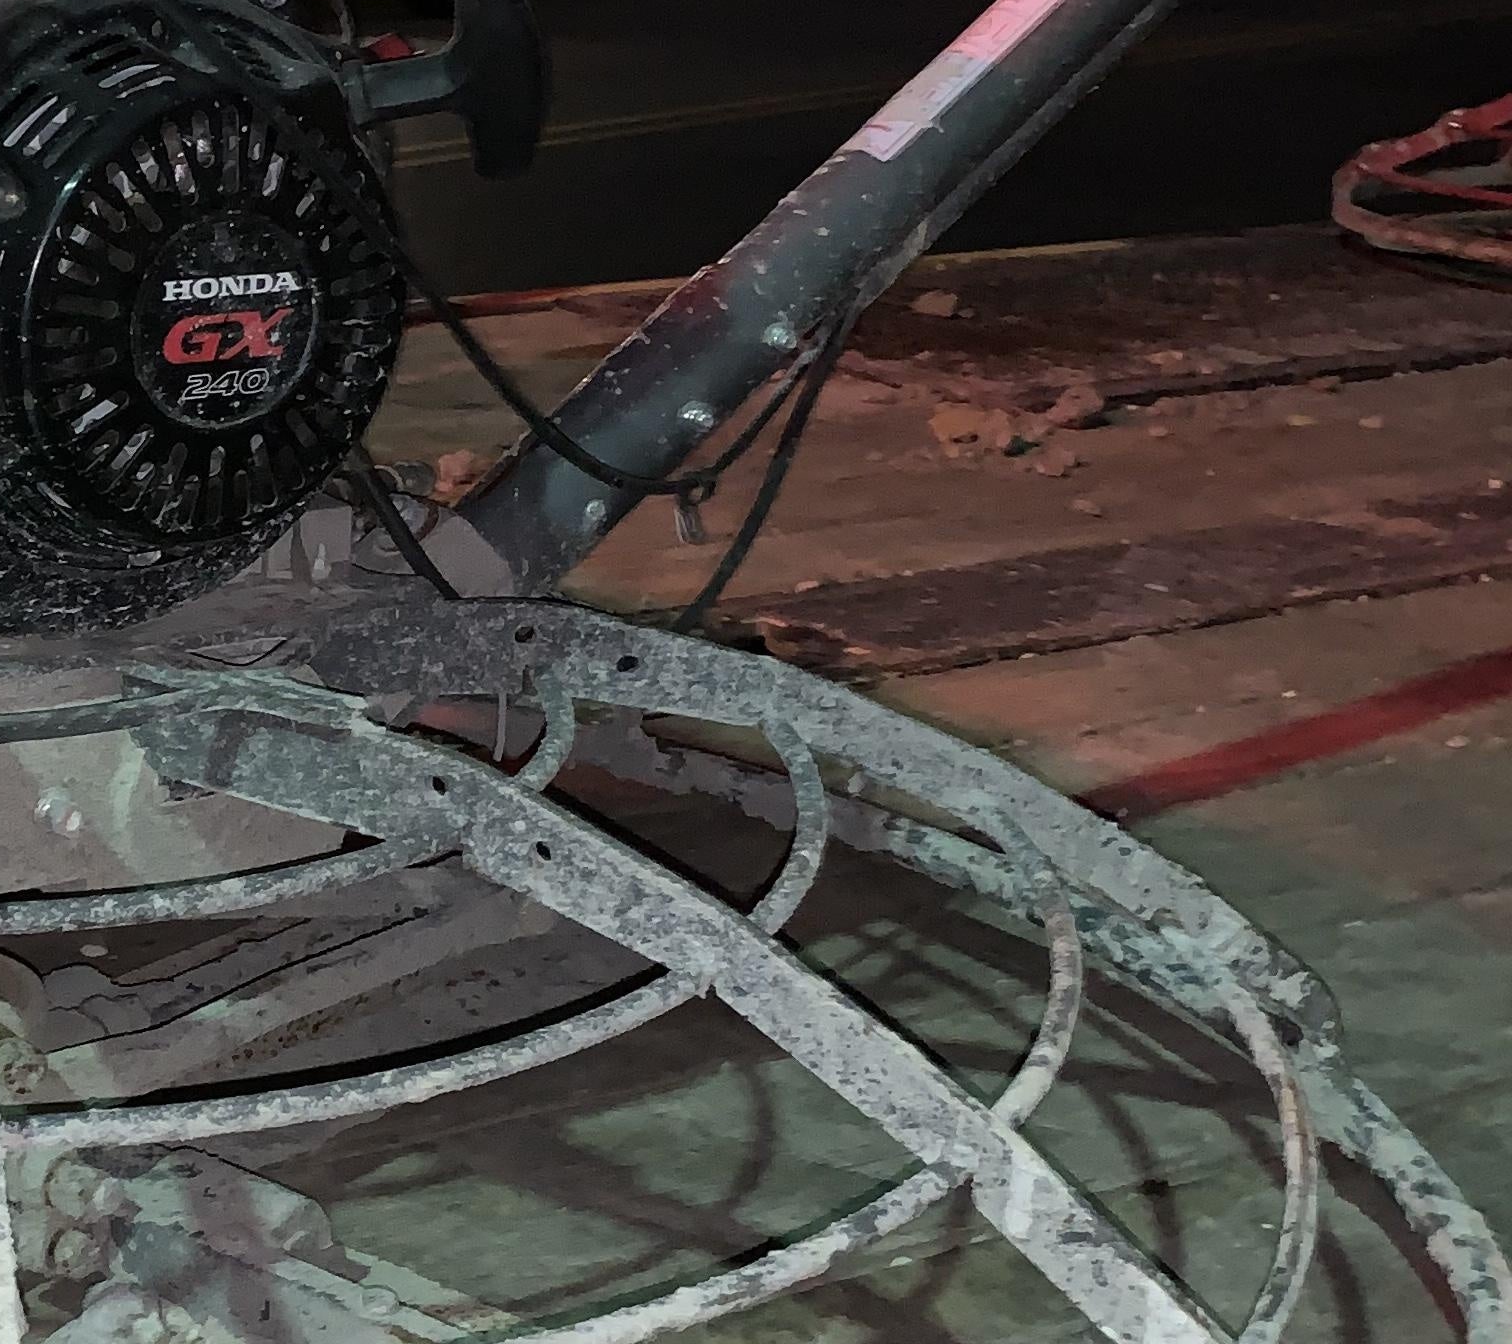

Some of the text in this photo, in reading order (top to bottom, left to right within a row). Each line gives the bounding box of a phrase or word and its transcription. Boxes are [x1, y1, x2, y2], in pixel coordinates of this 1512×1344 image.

[162, 272, 303, 301] HONDA
[162, 308, 294, 365] GX
[180, 368, 270, 401] 240
